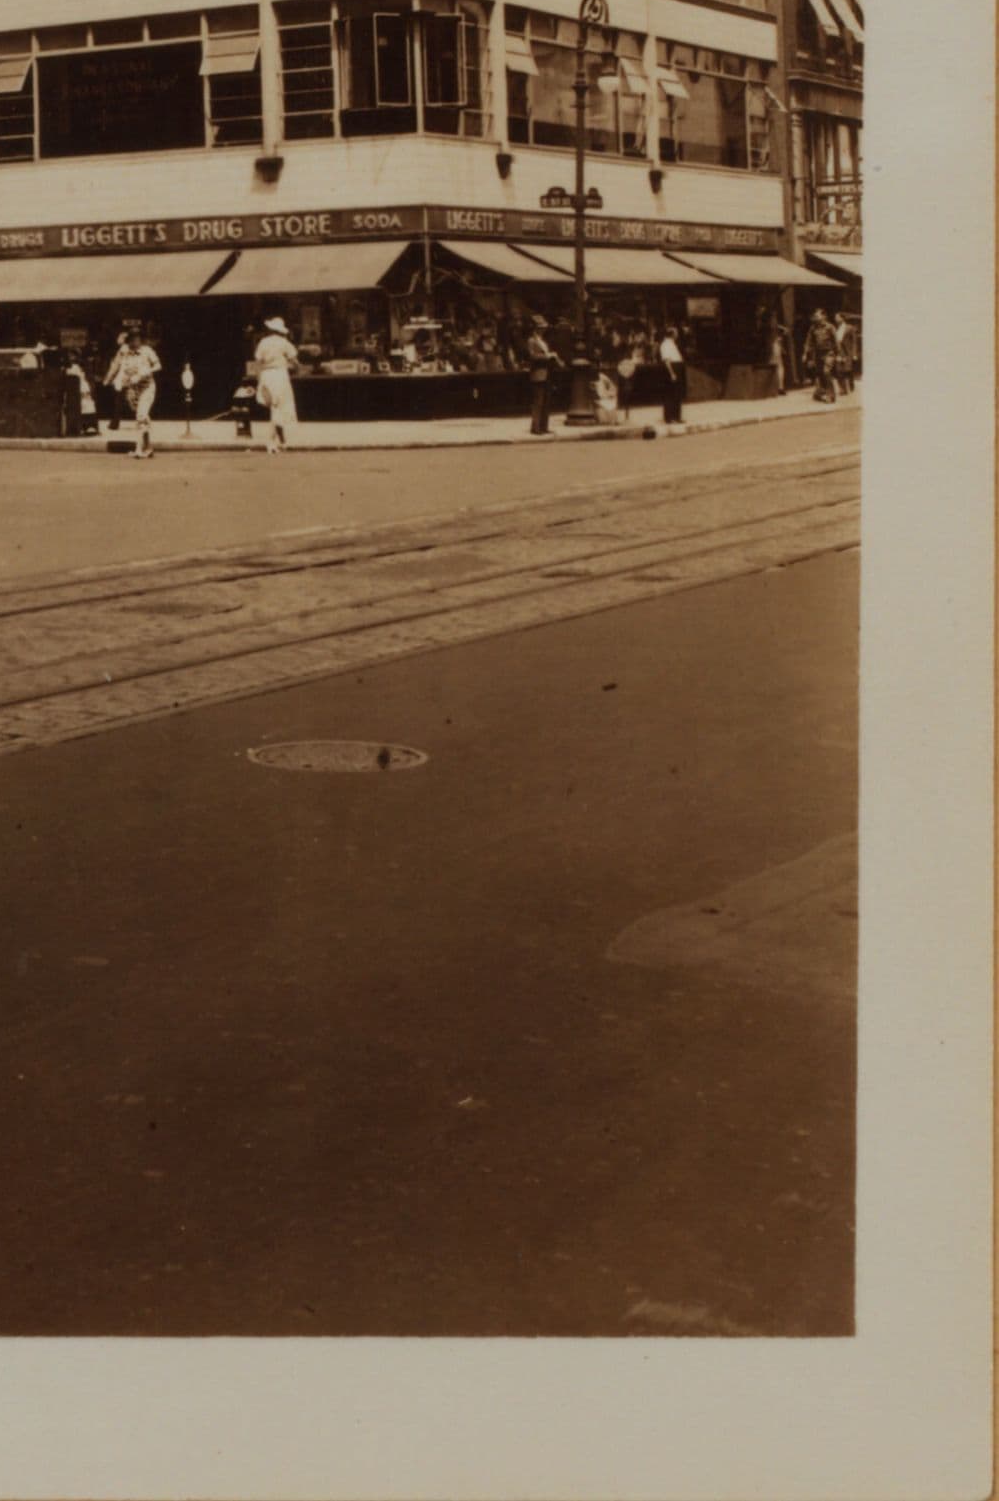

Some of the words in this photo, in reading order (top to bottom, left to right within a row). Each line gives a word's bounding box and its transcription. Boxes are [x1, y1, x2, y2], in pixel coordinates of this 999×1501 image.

[0, 231, 44, 248] DRUGS
[61, 223, 167, 247] LIGGETT'S
[183, 218, 244, 242] DRUG
[260, 214, 331, 237] STORE
[353, 213, 402, 229] SODA
